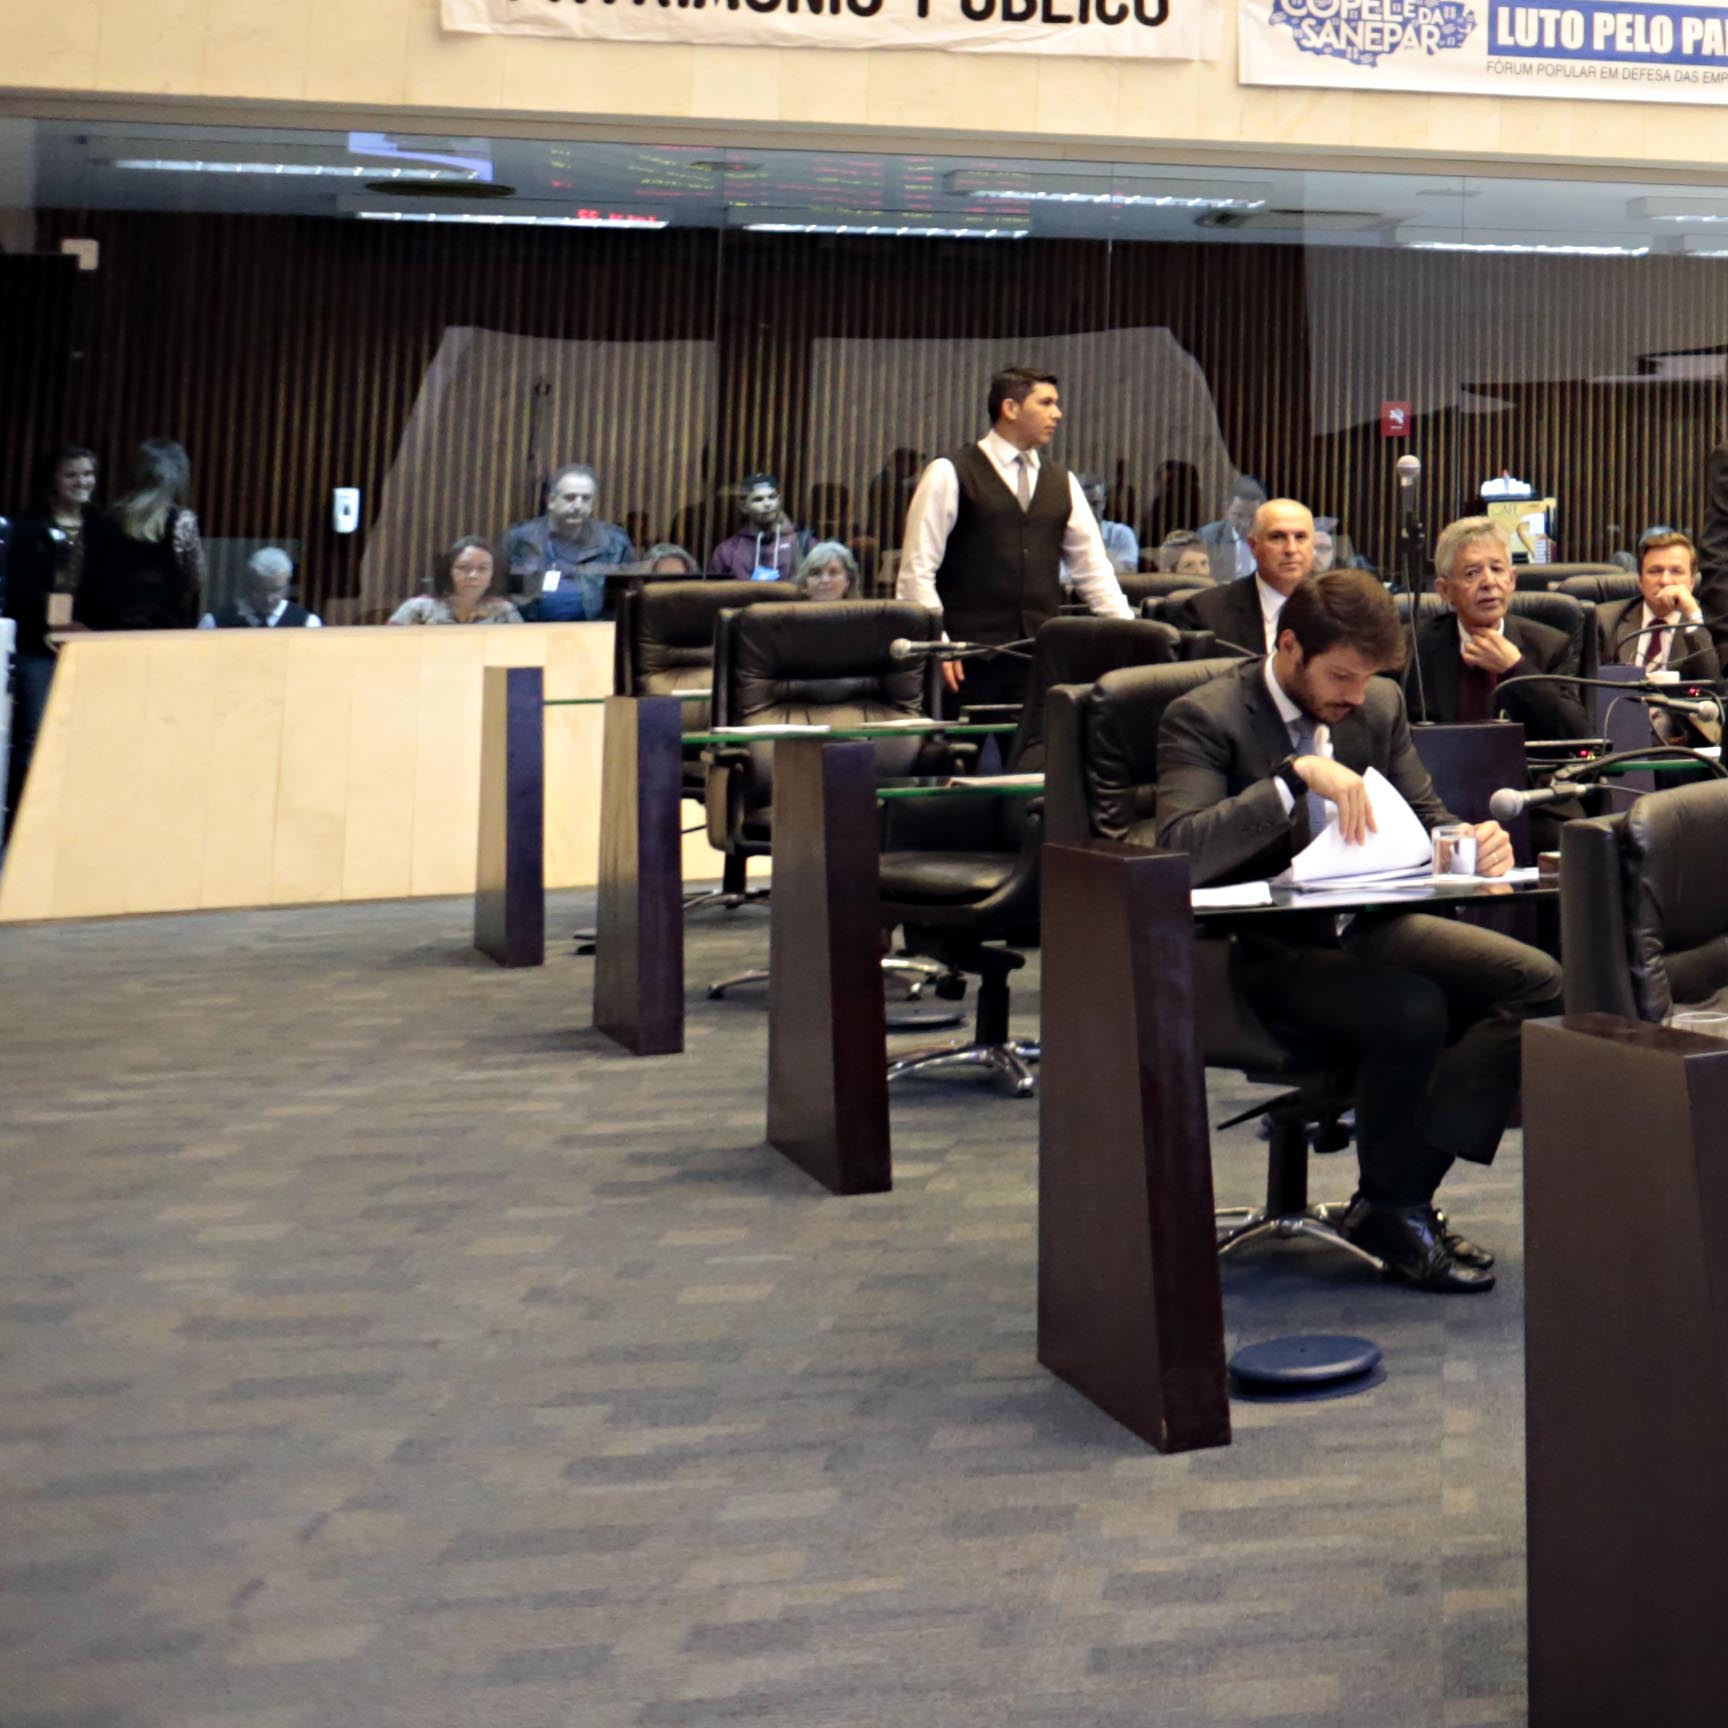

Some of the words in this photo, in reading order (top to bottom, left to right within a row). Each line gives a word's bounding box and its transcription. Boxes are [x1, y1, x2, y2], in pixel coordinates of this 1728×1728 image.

[1417, 7, 1445, 25] DA
[1497, 6, 1585, 50] LUTO
[1593, 13, 1674, 54] PELO
[1300, 17, 1440, 56] SANEPAR
[1486, 60, 1534, 77] FÓRUM
[1536, 63, 1597, 79] POPULAR
[1600, 66, 1619, 80] EM
[1622, 67, 1671, 82] DEFESA
[1674, 69, 1699, 83] DAS
